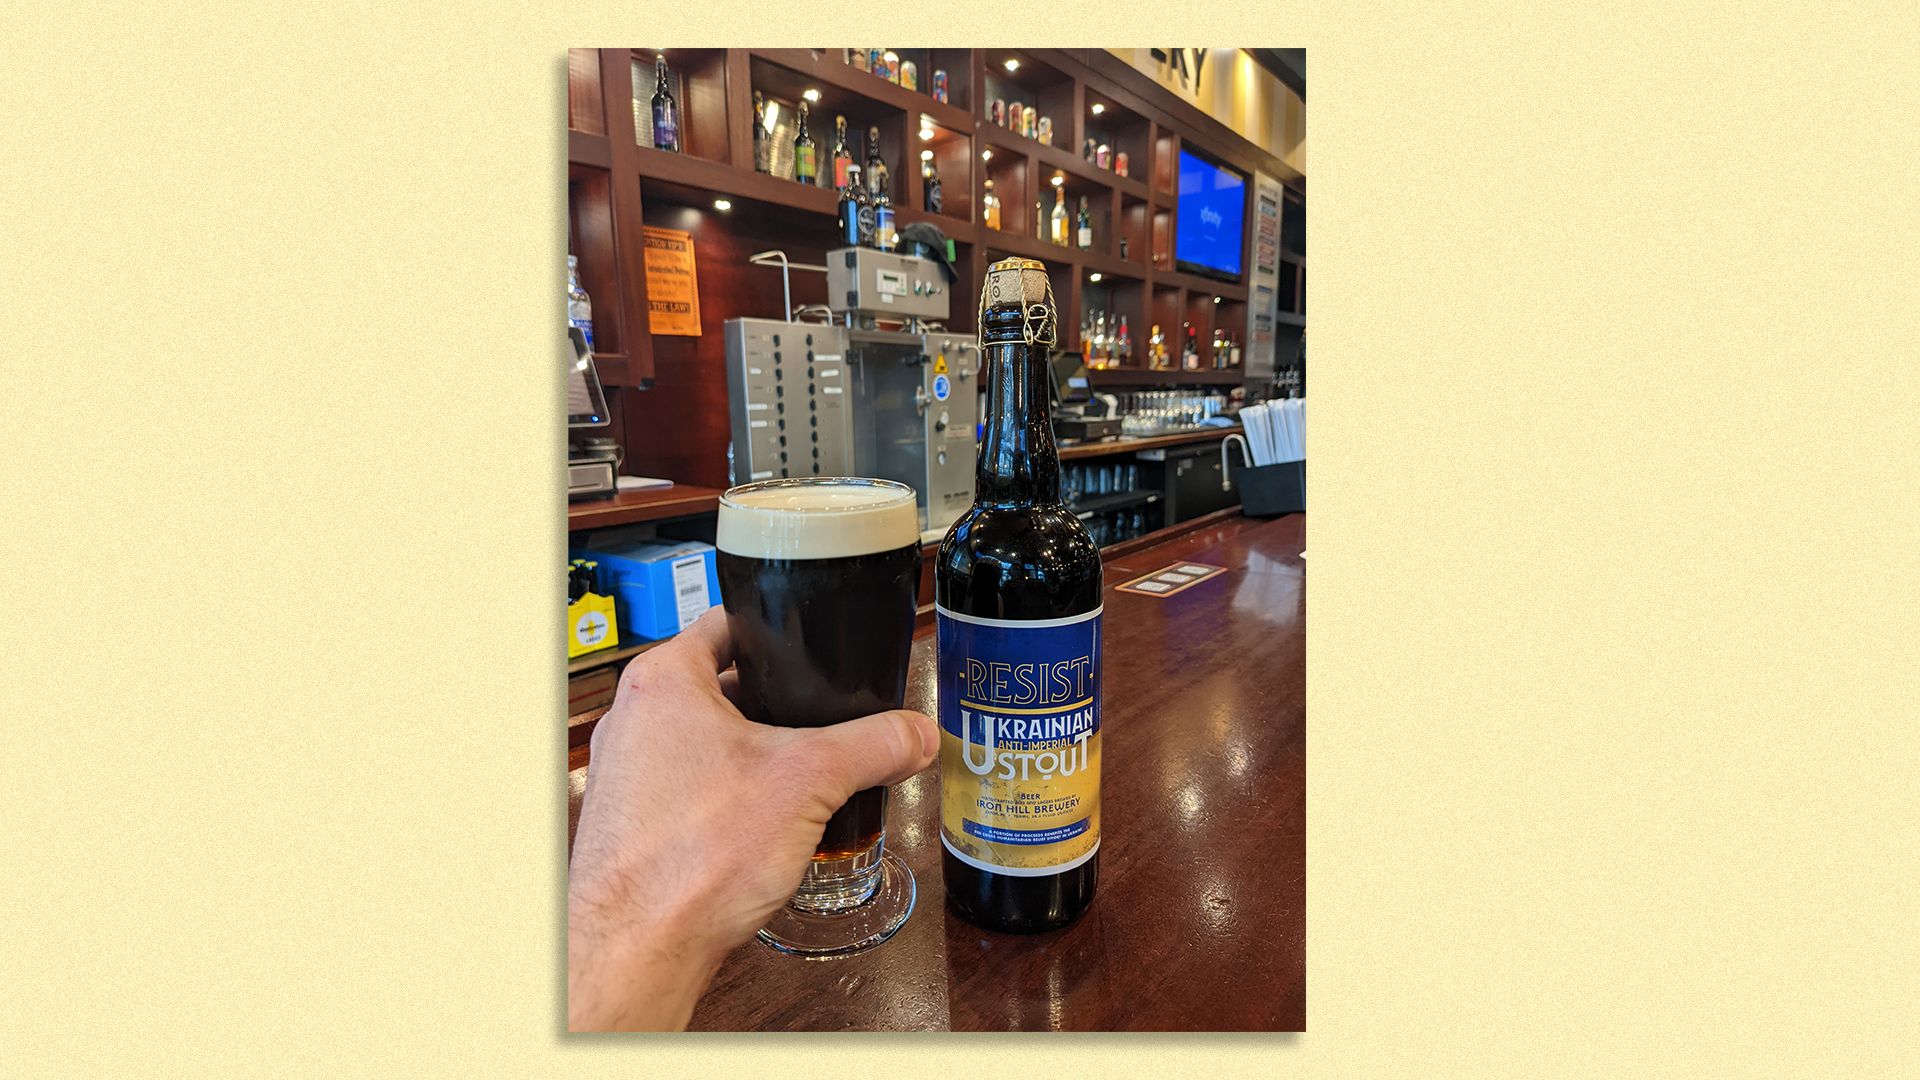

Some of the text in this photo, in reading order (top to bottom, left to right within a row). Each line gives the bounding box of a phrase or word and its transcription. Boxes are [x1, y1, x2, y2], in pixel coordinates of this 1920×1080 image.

[966, 655, 1090, 705] RESIST
[961, 707, 1093, 776] UKRAINIAN
[998, 737, 1072, 751] ANTI-IMPERIAL
[998, 728, 1093, 780] STOUT
[976, 796, 1081, 814] IRON HILL BREWERY
